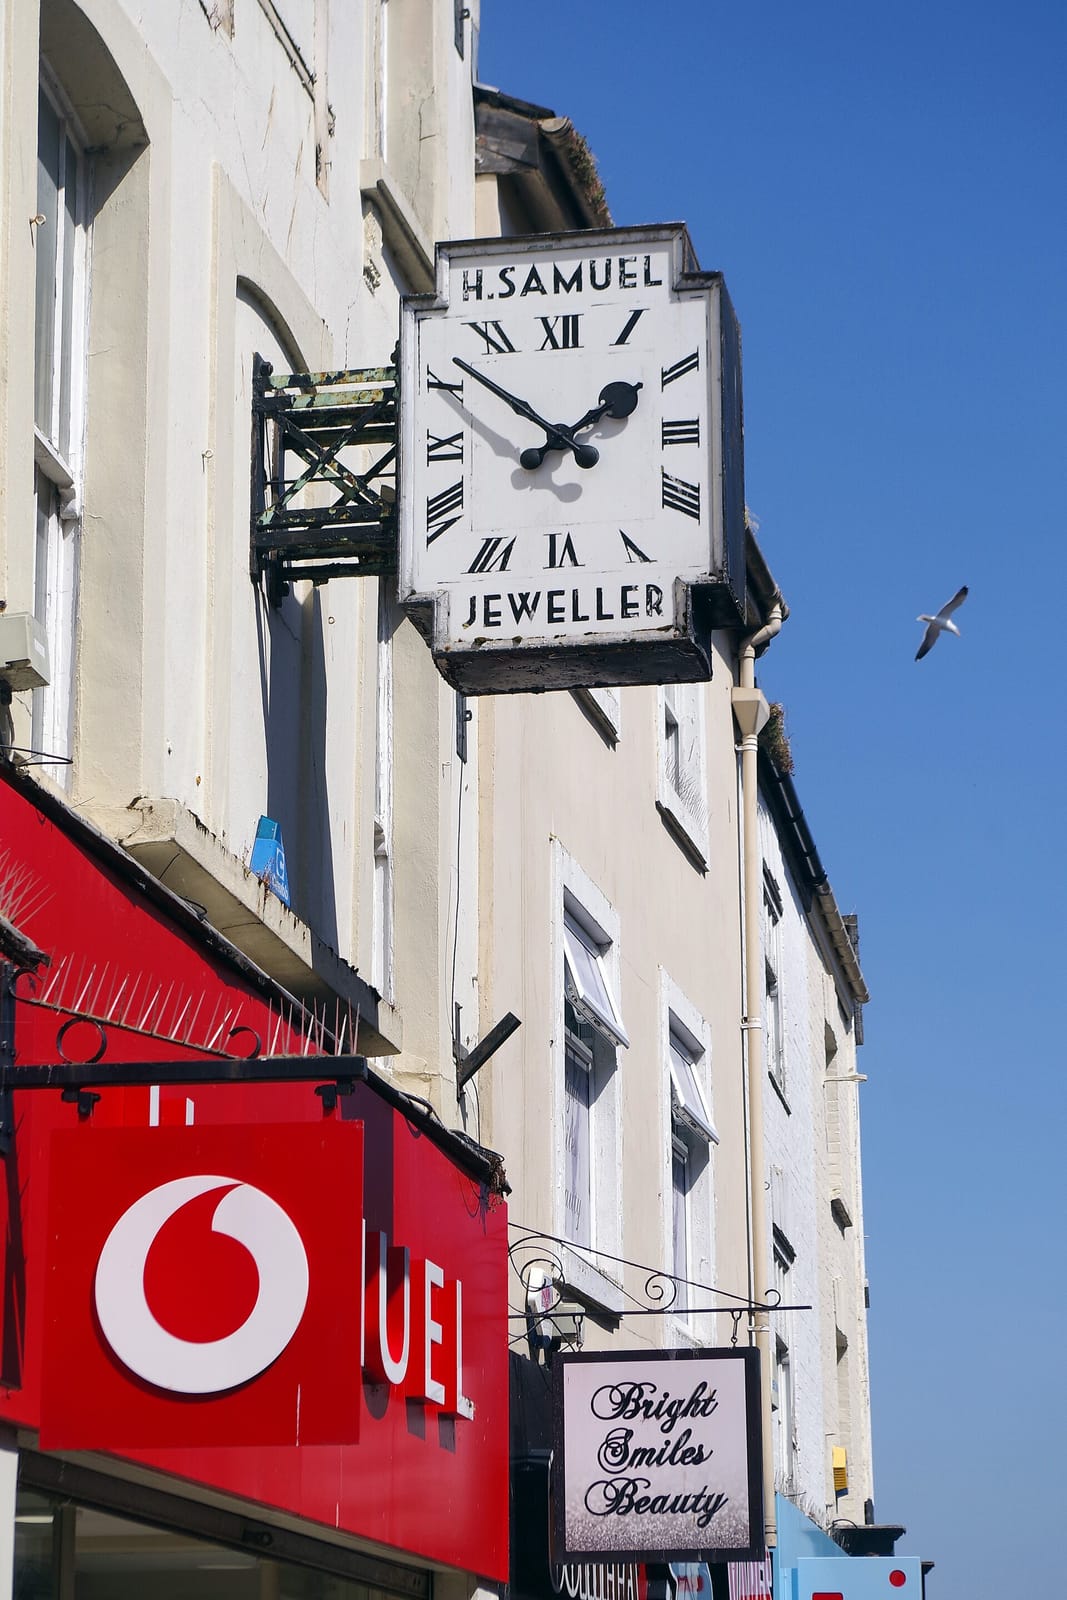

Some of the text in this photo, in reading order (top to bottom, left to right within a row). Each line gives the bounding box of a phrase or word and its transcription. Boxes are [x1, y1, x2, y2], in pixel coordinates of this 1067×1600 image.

[535, 314, 585, 351] XII
[463, 584, 664, 629] JEWELLER
[361, 1218, 475, 1420] UEL
[591, 1381, 719, 1433] Bright
[597, 1427, 713, 1474] Smiles
[584, 1477, 729, 1528] Beauty
